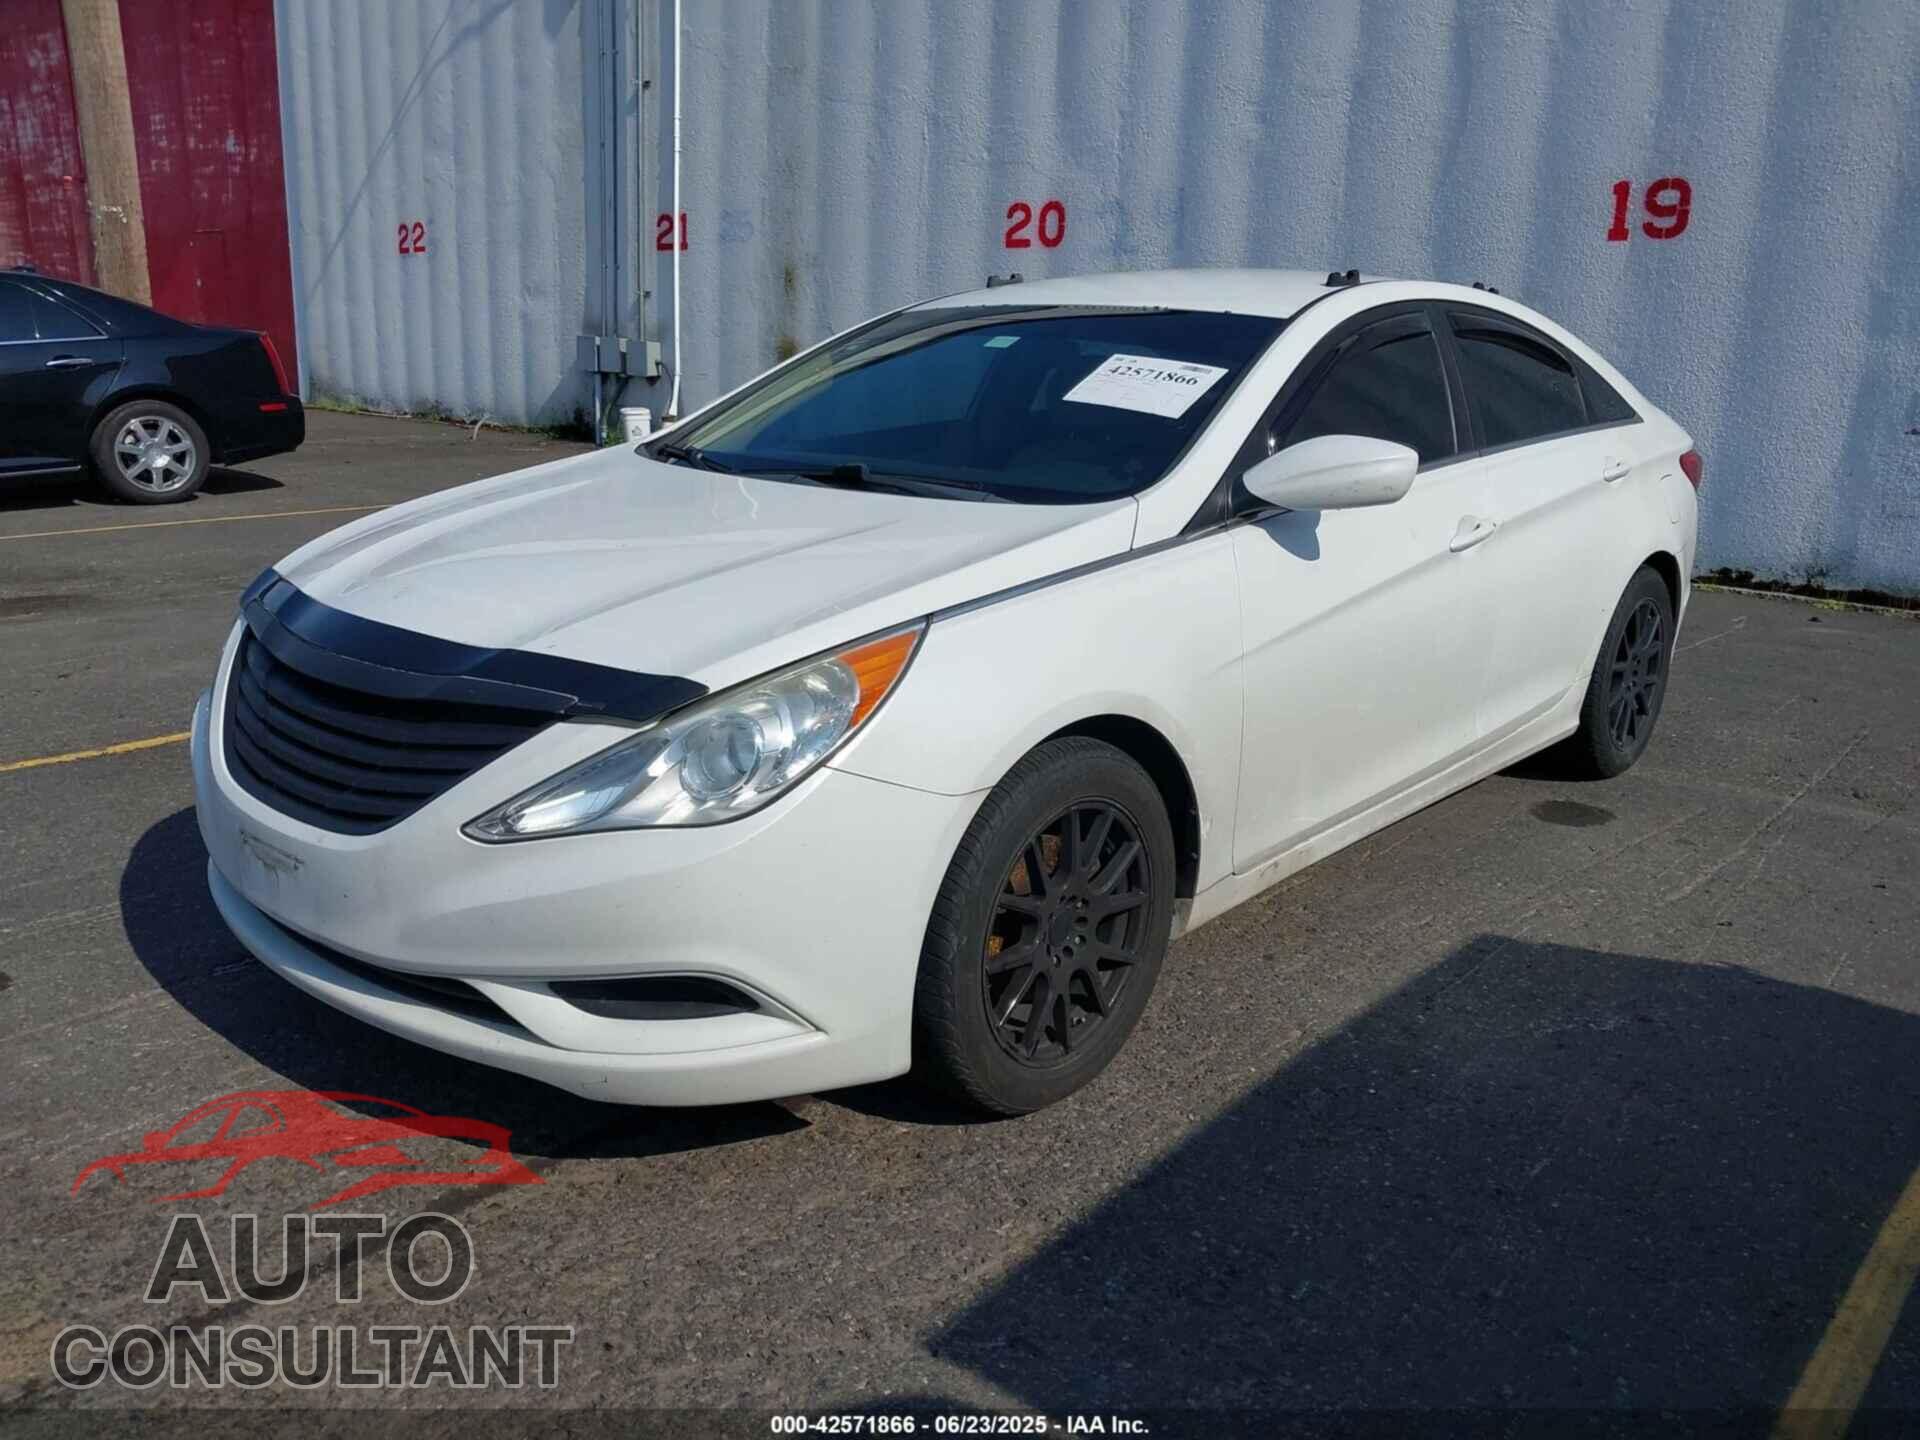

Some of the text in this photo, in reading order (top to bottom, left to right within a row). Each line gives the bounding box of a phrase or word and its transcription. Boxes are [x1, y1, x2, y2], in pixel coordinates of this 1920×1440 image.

[1005, 201, 1066, 248] 20
[1607, 177, 1692, 241] 19
[398, 222, 426, 254] 22
[656, 213, 688, 251] 21
[1108, 365, 1199, 386] 42571866
